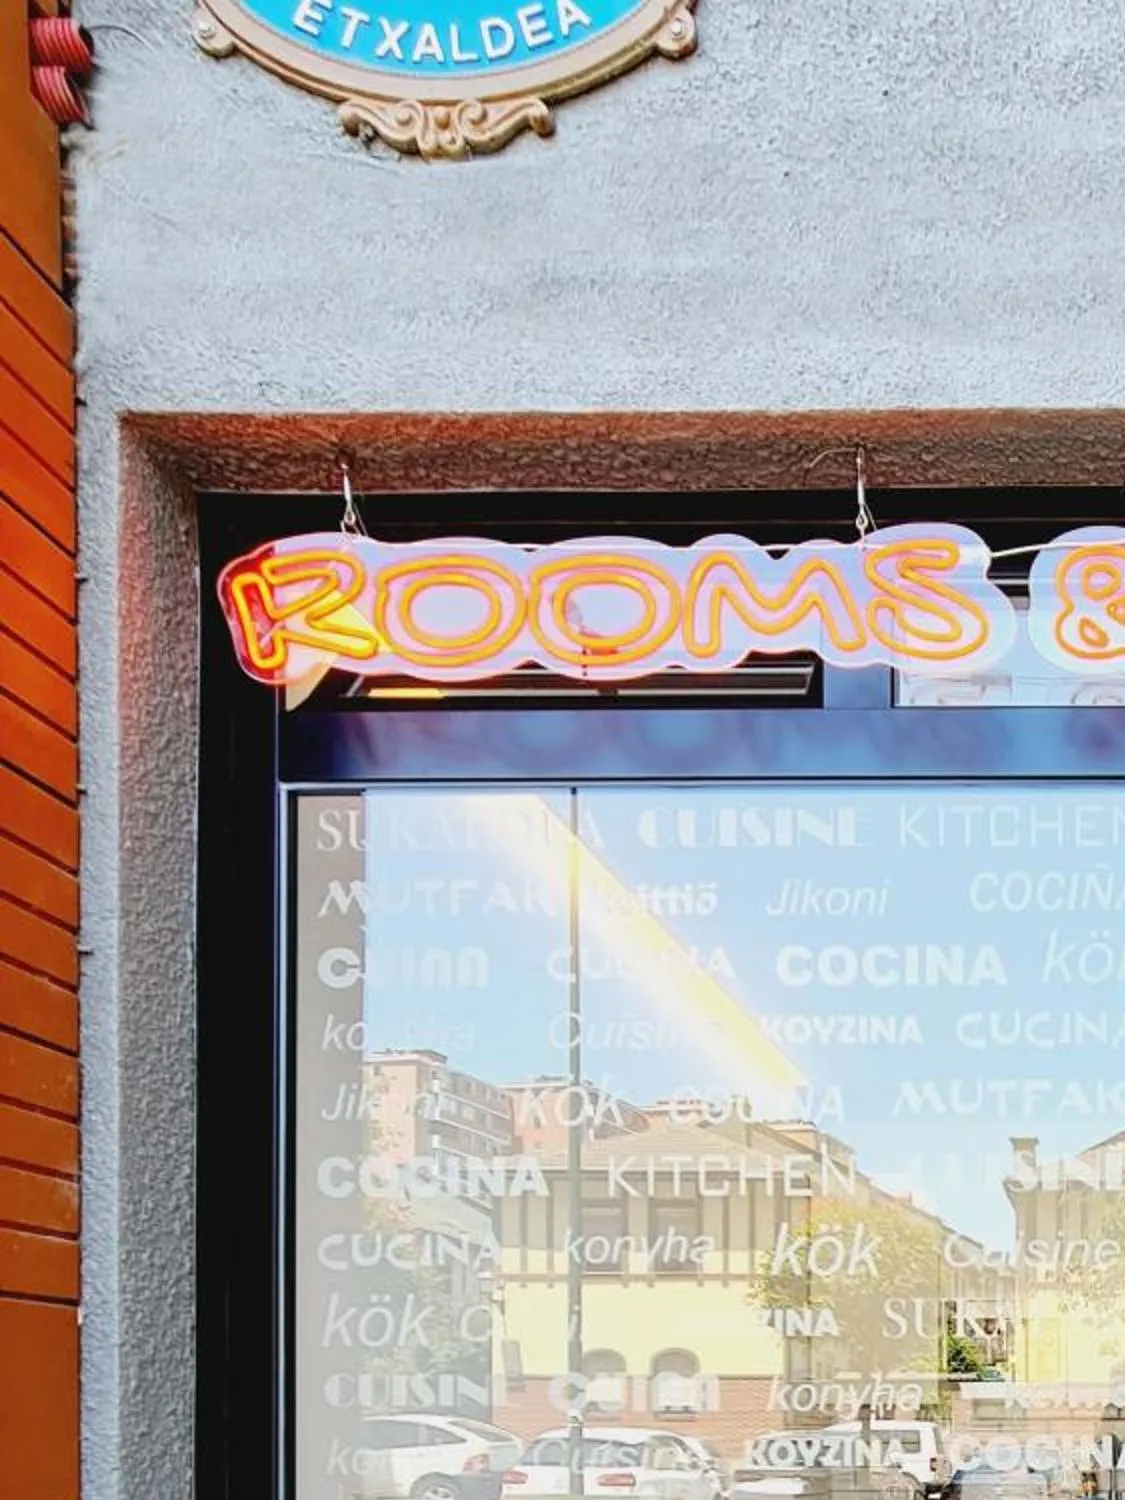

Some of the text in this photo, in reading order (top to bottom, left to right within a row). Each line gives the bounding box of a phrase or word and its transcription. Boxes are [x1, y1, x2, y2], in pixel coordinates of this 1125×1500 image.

[292, 0, 592, 63] ETXALDEA
[232, 537, 990, 668] ROOMS
[637, 806, 872, 848] CUISINE
[766, 876, 890, 918] Jikoni
[776, 943, 1008, 987] COCINA
[761, 1015, 924, 1046] KOYZINA
[317, 1155, 550, 1197] COCINA
[608, 1153, 856, 1197] KITCHEN
[318, 1232, 503, 1271] CUCINA
[563, 1225, 715, 1266] konyha
[771, 1222, 881, 1278] kök
[943, 1234, 1121, 1268] Cuisine
[321, 1292, 436, 1349] kök
[766, 1373, 924, 1421] konyha
[744, 1437, 904, 1468] KOYZINA
